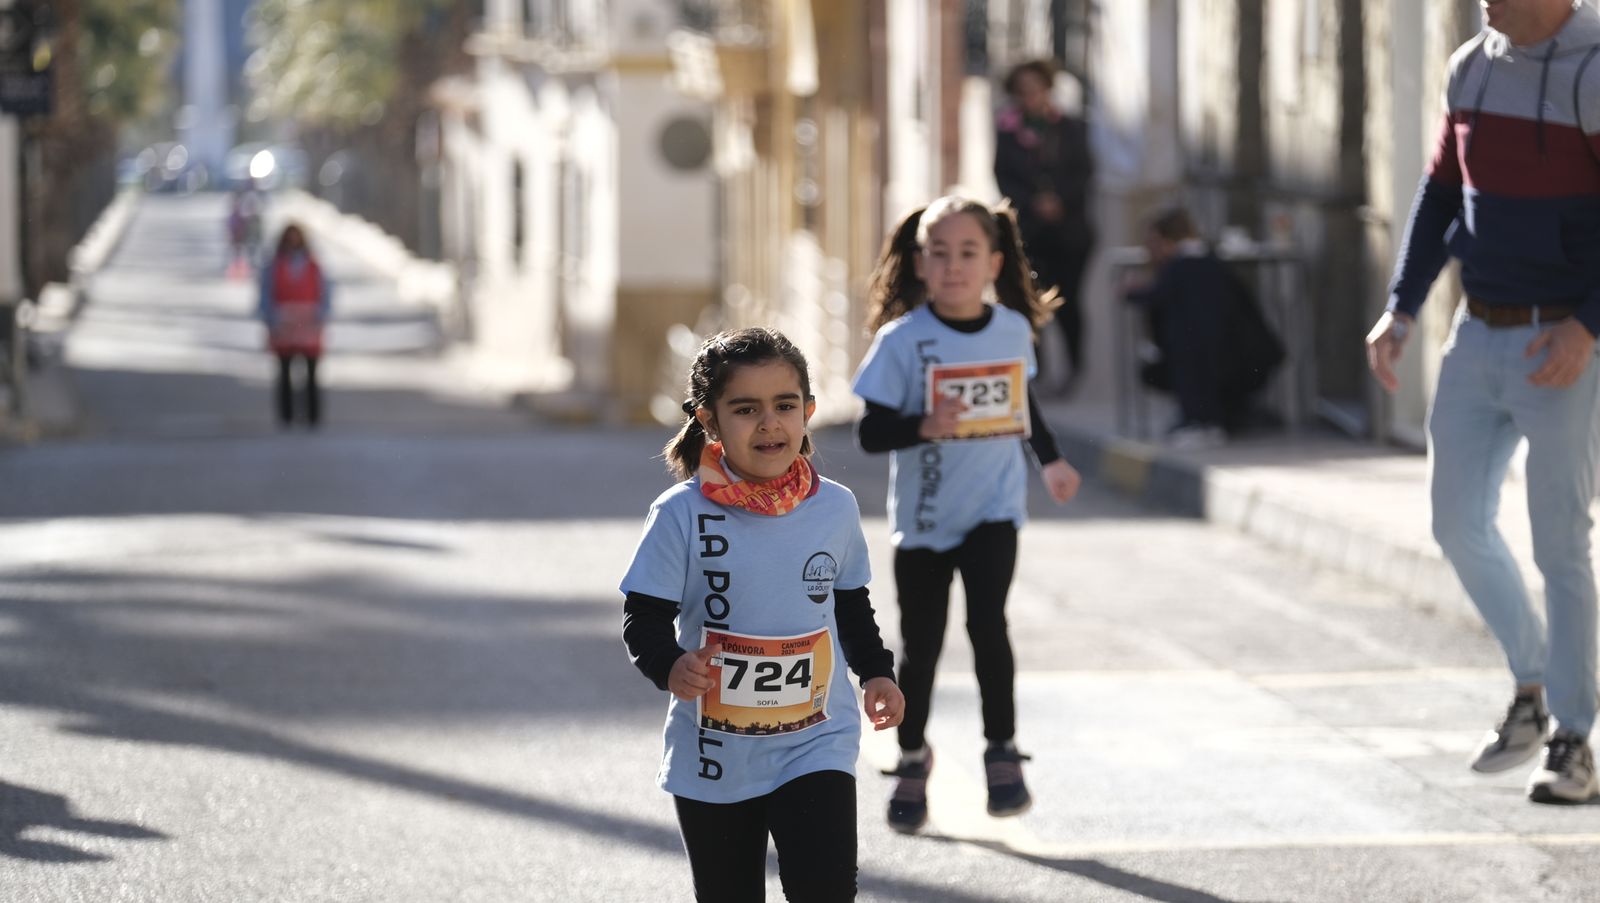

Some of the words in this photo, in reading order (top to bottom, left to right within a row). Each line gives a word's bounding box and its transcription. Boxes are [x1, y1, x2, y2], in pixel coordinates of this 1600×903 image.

[948, 381, 1009, 406] 723
[698, 513, 729, 558] LA
[727, 642, 765, 655] PÓLVORA
[781, 639, 811, 650] CANTORIA
[723, 657, 811, 692] 724
